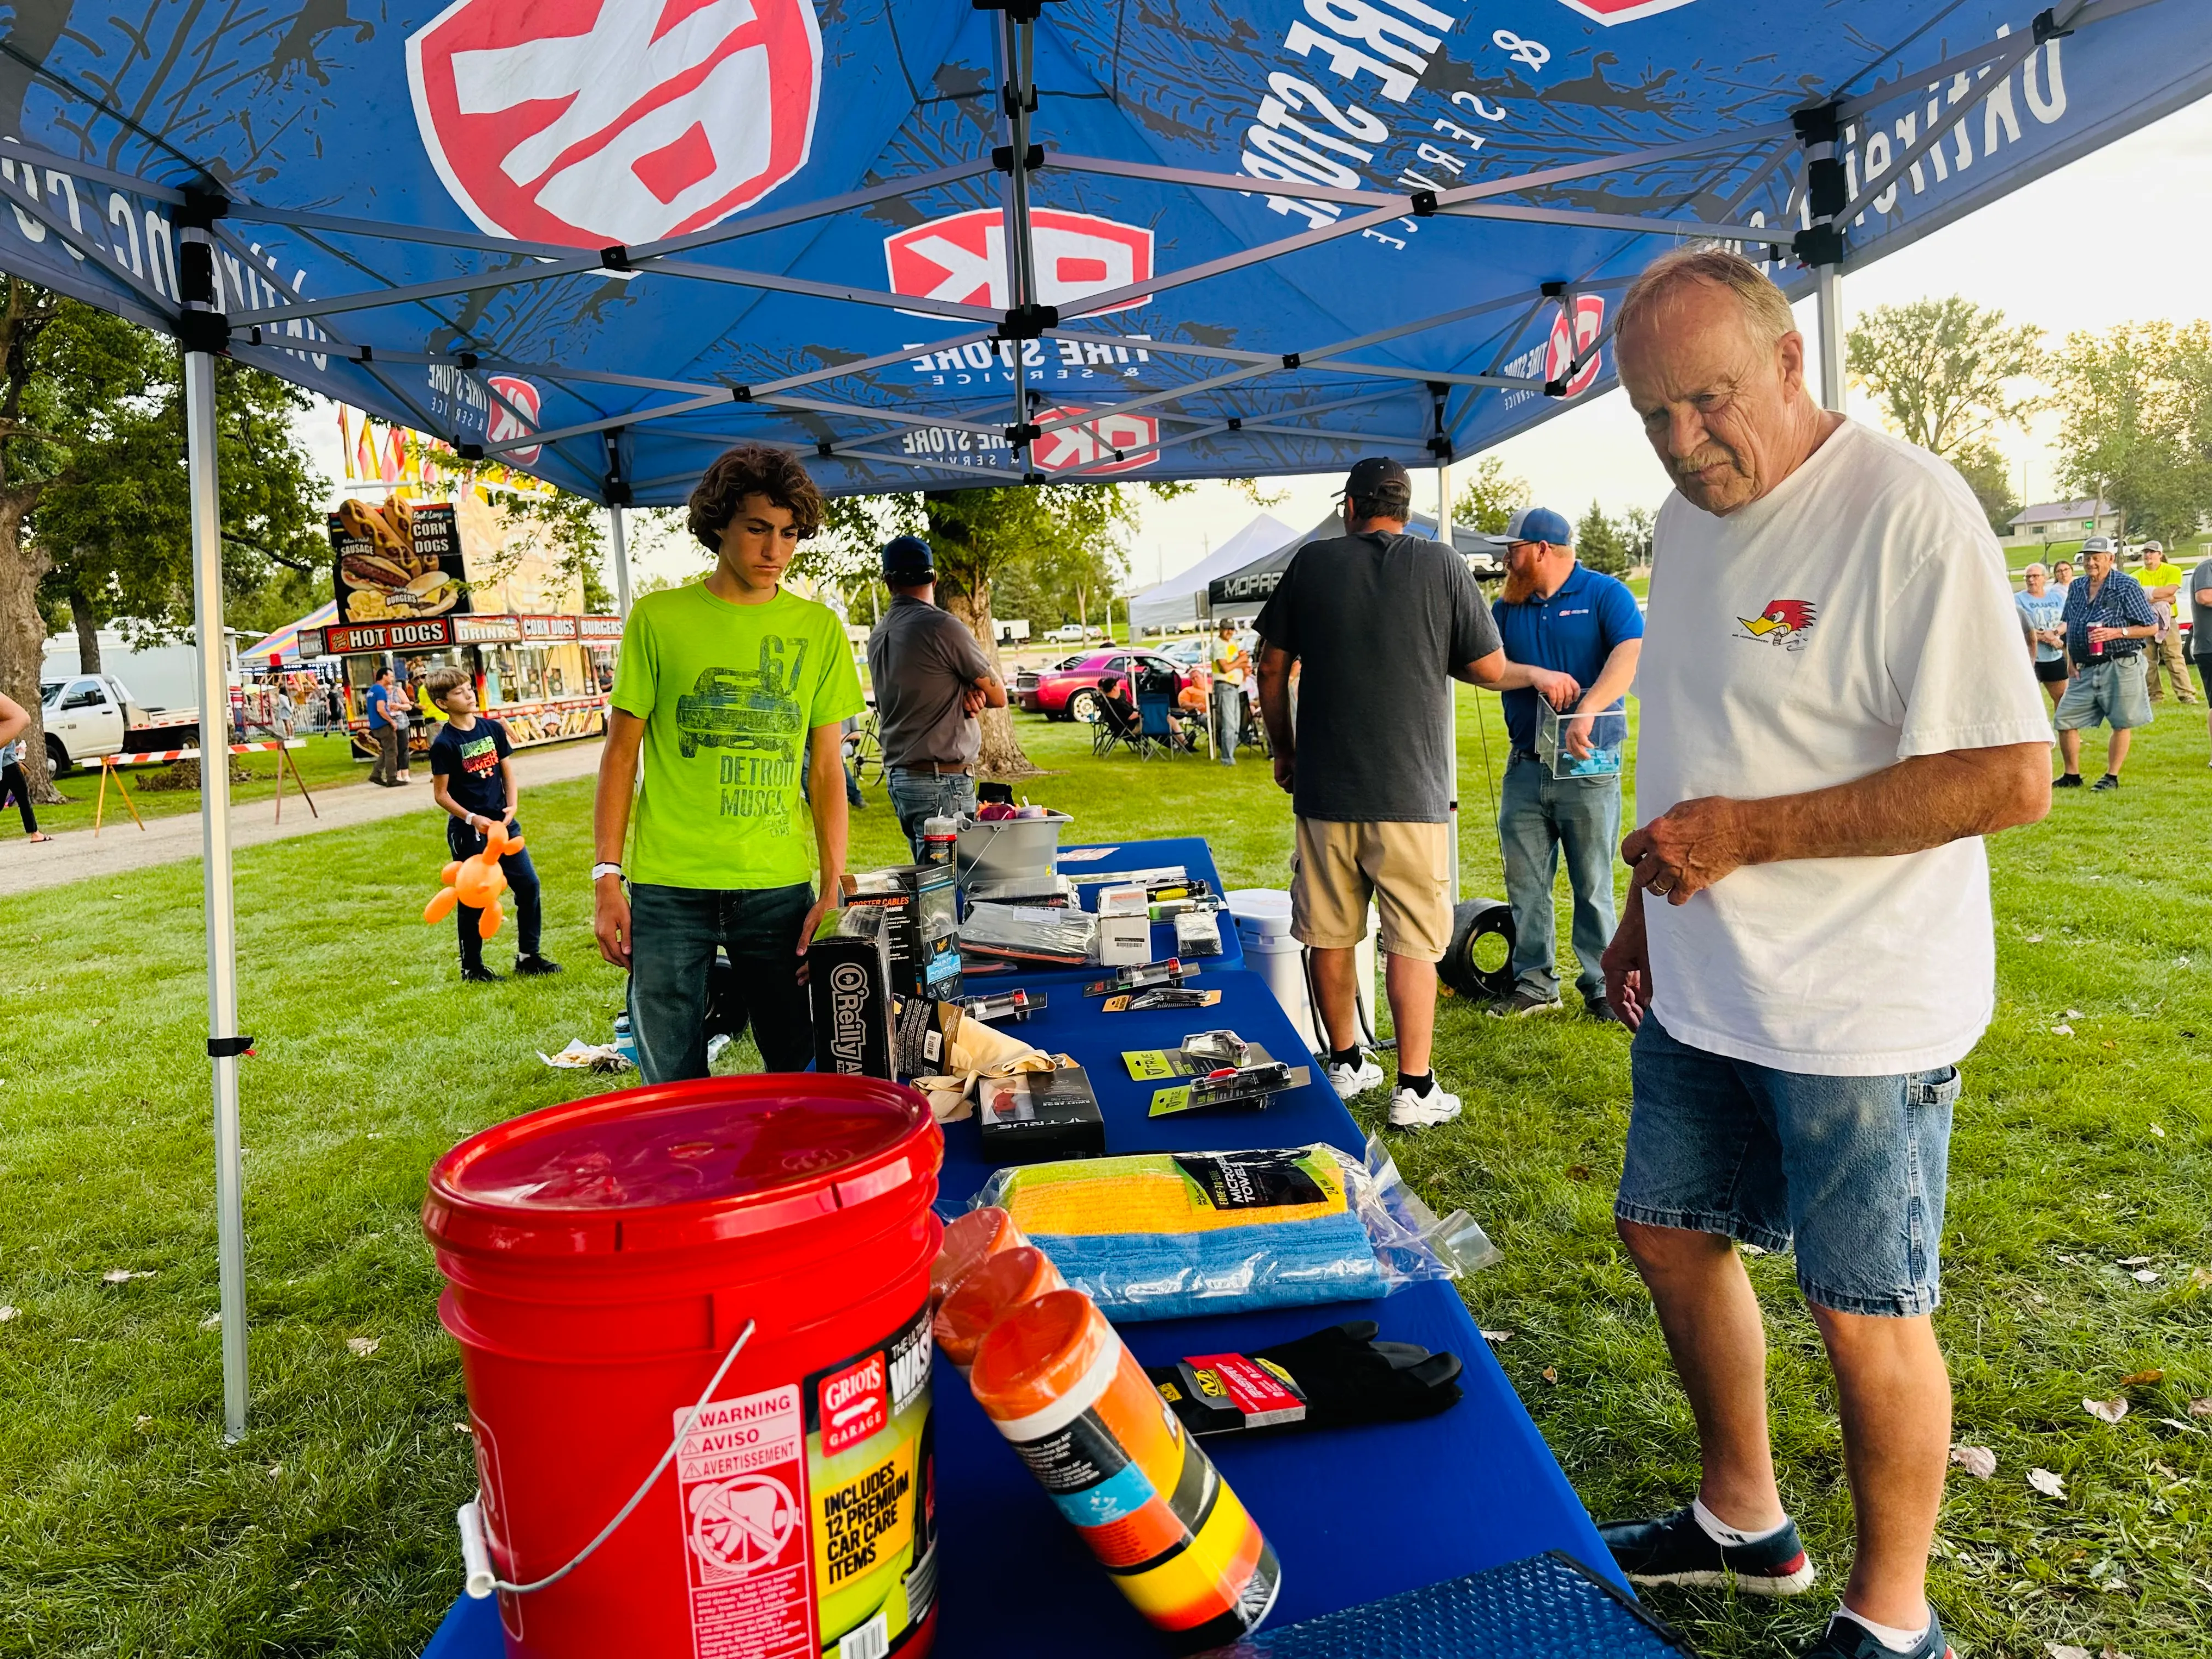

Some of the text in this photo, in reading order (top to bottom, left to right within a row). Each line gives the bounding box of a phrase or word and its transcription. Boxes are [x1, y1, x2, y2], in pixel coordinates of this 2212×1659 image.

[413, 522, 447, 537] CORN
[340, 544, 374, 557] SAUSAGE
[415, 538, 449, 554] DOGS
[386, 594, 417, 605] BURGERS
[348, 623, 443, 647] HOT DOGS
[459, 626, 518, 641] DRINKS
[523, 619, 575, 635] CORN DOGS
[581, 620, 623, 635] BURGERS
[759, 635, 809, 694] 67
[720, 755, 797, 786] DETROIT
[882, 896, 910, 906] CABLES
[834, 966, 866, 1057] O'Reilly
[1141, 1053, 1158, 1068] TRUE
[997, 1120, 1061, 1130] TRUE
[891, 1336, 908, 1360] THE
[825, 1359, 881, 1411] GRIOT'S
[699, 1395, 791, 1427] WARNING
[702, 1428, 759, 1453] AVISO
[829, 1410, 882, 1447] GARAGE
[703, 1441, 795, 1476] AVERTISSEMENT
[824, 1460, 895, 1518] INCLUDES
[826, 1469, 909, 1540] 12 PREMIUM
[827, 1502, 898, 1562] CAR CARE
[828, 1542, 876, 1585] ITEMS
[696, 1590, 729, 1600] Children
